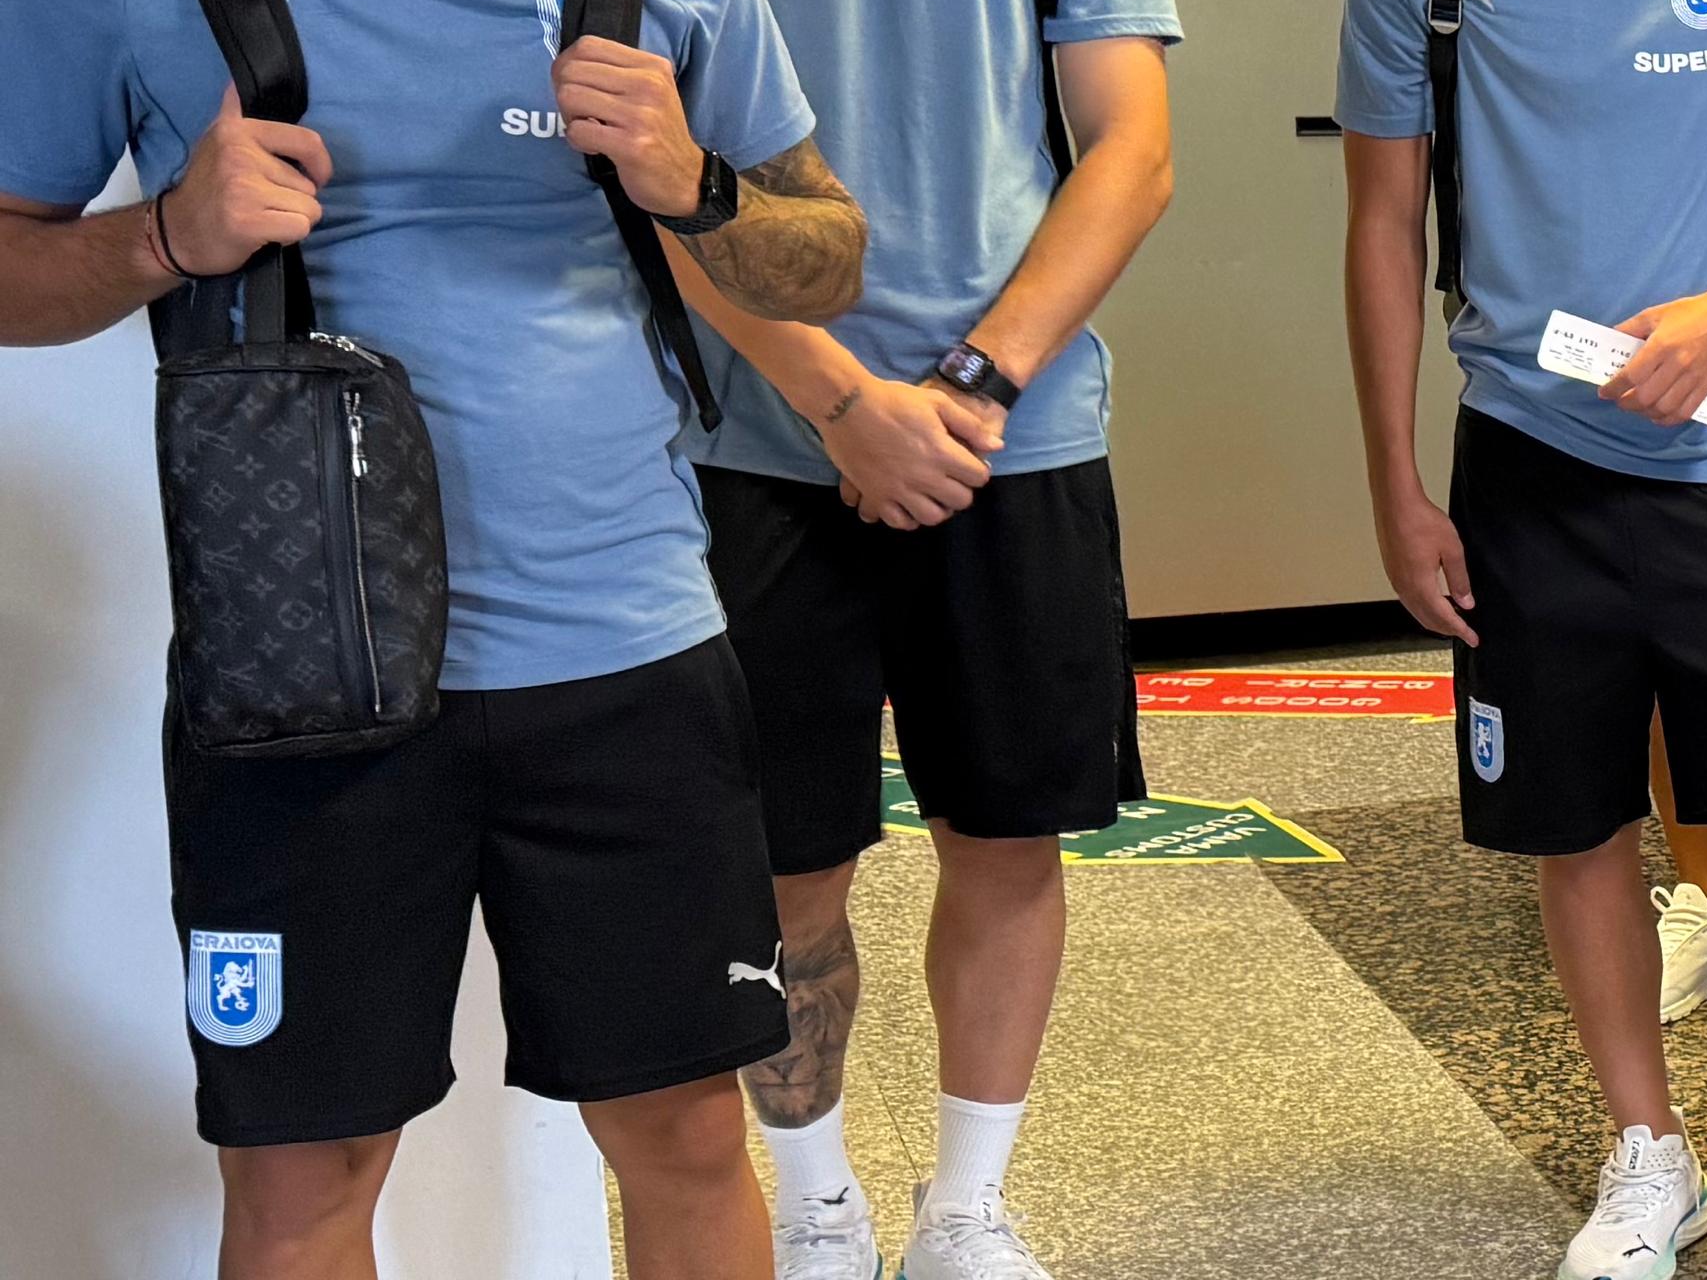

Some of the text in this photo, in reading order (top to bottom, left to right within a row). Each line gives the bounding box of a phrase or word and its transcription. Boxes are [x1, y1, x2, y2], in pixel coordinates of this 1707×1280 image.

[1149, 677, 1434, 690] BUNURI DE
[1221, 695, 1382, 707] GOODS
[1104, 812, 1255, 858] CUSTOMS
[1165, 826, 1268, 855] VAMA
[192, 933, 277, 950] CRAIOVA
